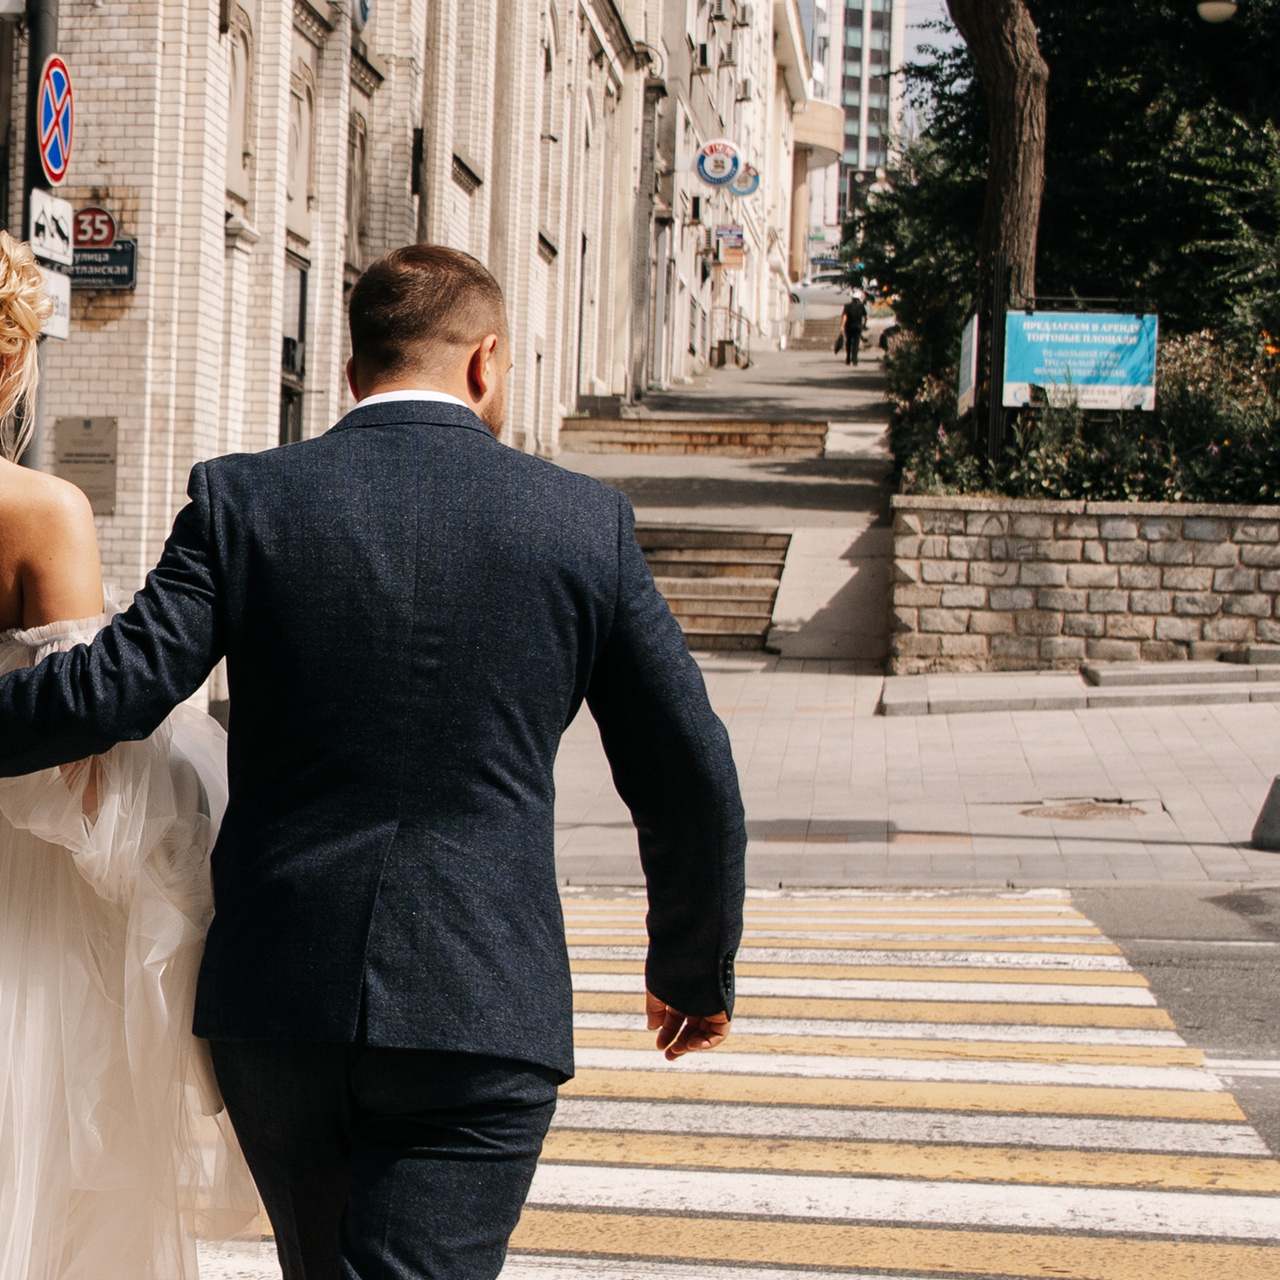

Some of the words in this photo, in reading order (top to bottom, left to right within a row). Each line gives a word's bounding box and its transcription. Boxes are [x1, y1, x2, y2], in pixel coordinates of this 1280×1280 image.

[77, 214, 109, 242] 35
[74, 252, 109, 264] улица
[1023, 321, 1089, 332] ПРЕДЛАГАЕМ
[1091, 323, 1099, 332] В
[1100, 323, 1141, 334] АРЕНДУ
[1026, 333, 1081, 343] ТОРГОВЫЕ
[1082, 334, 1138, 345] ПЛОЩАДИ
